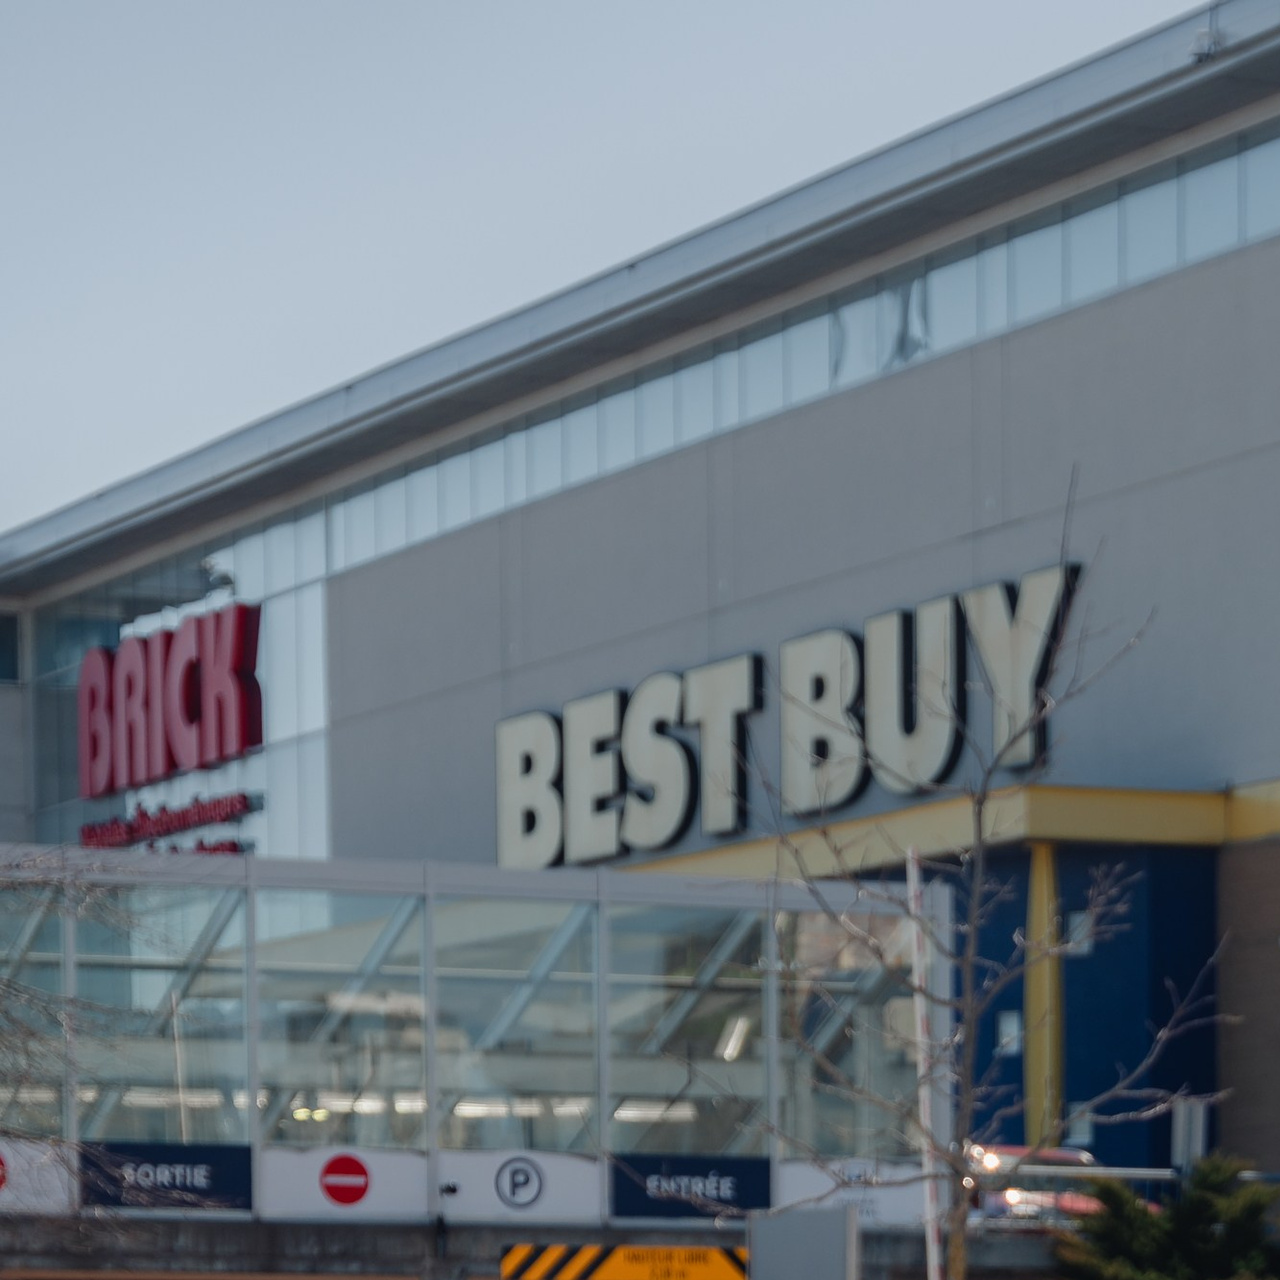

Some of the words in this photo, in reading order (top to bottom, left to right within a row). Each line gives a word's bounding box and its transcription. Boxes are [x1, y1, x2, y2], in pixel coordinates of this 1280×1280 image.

[80, 604, 259, 799] BRICK
[496, 653, 759, 869] BEST
[779, 563, 1074, 817] BUY
[121, 1163, 211, 1189] SORTIE
[646, 1170, 736, 1199] ENTRÉE
